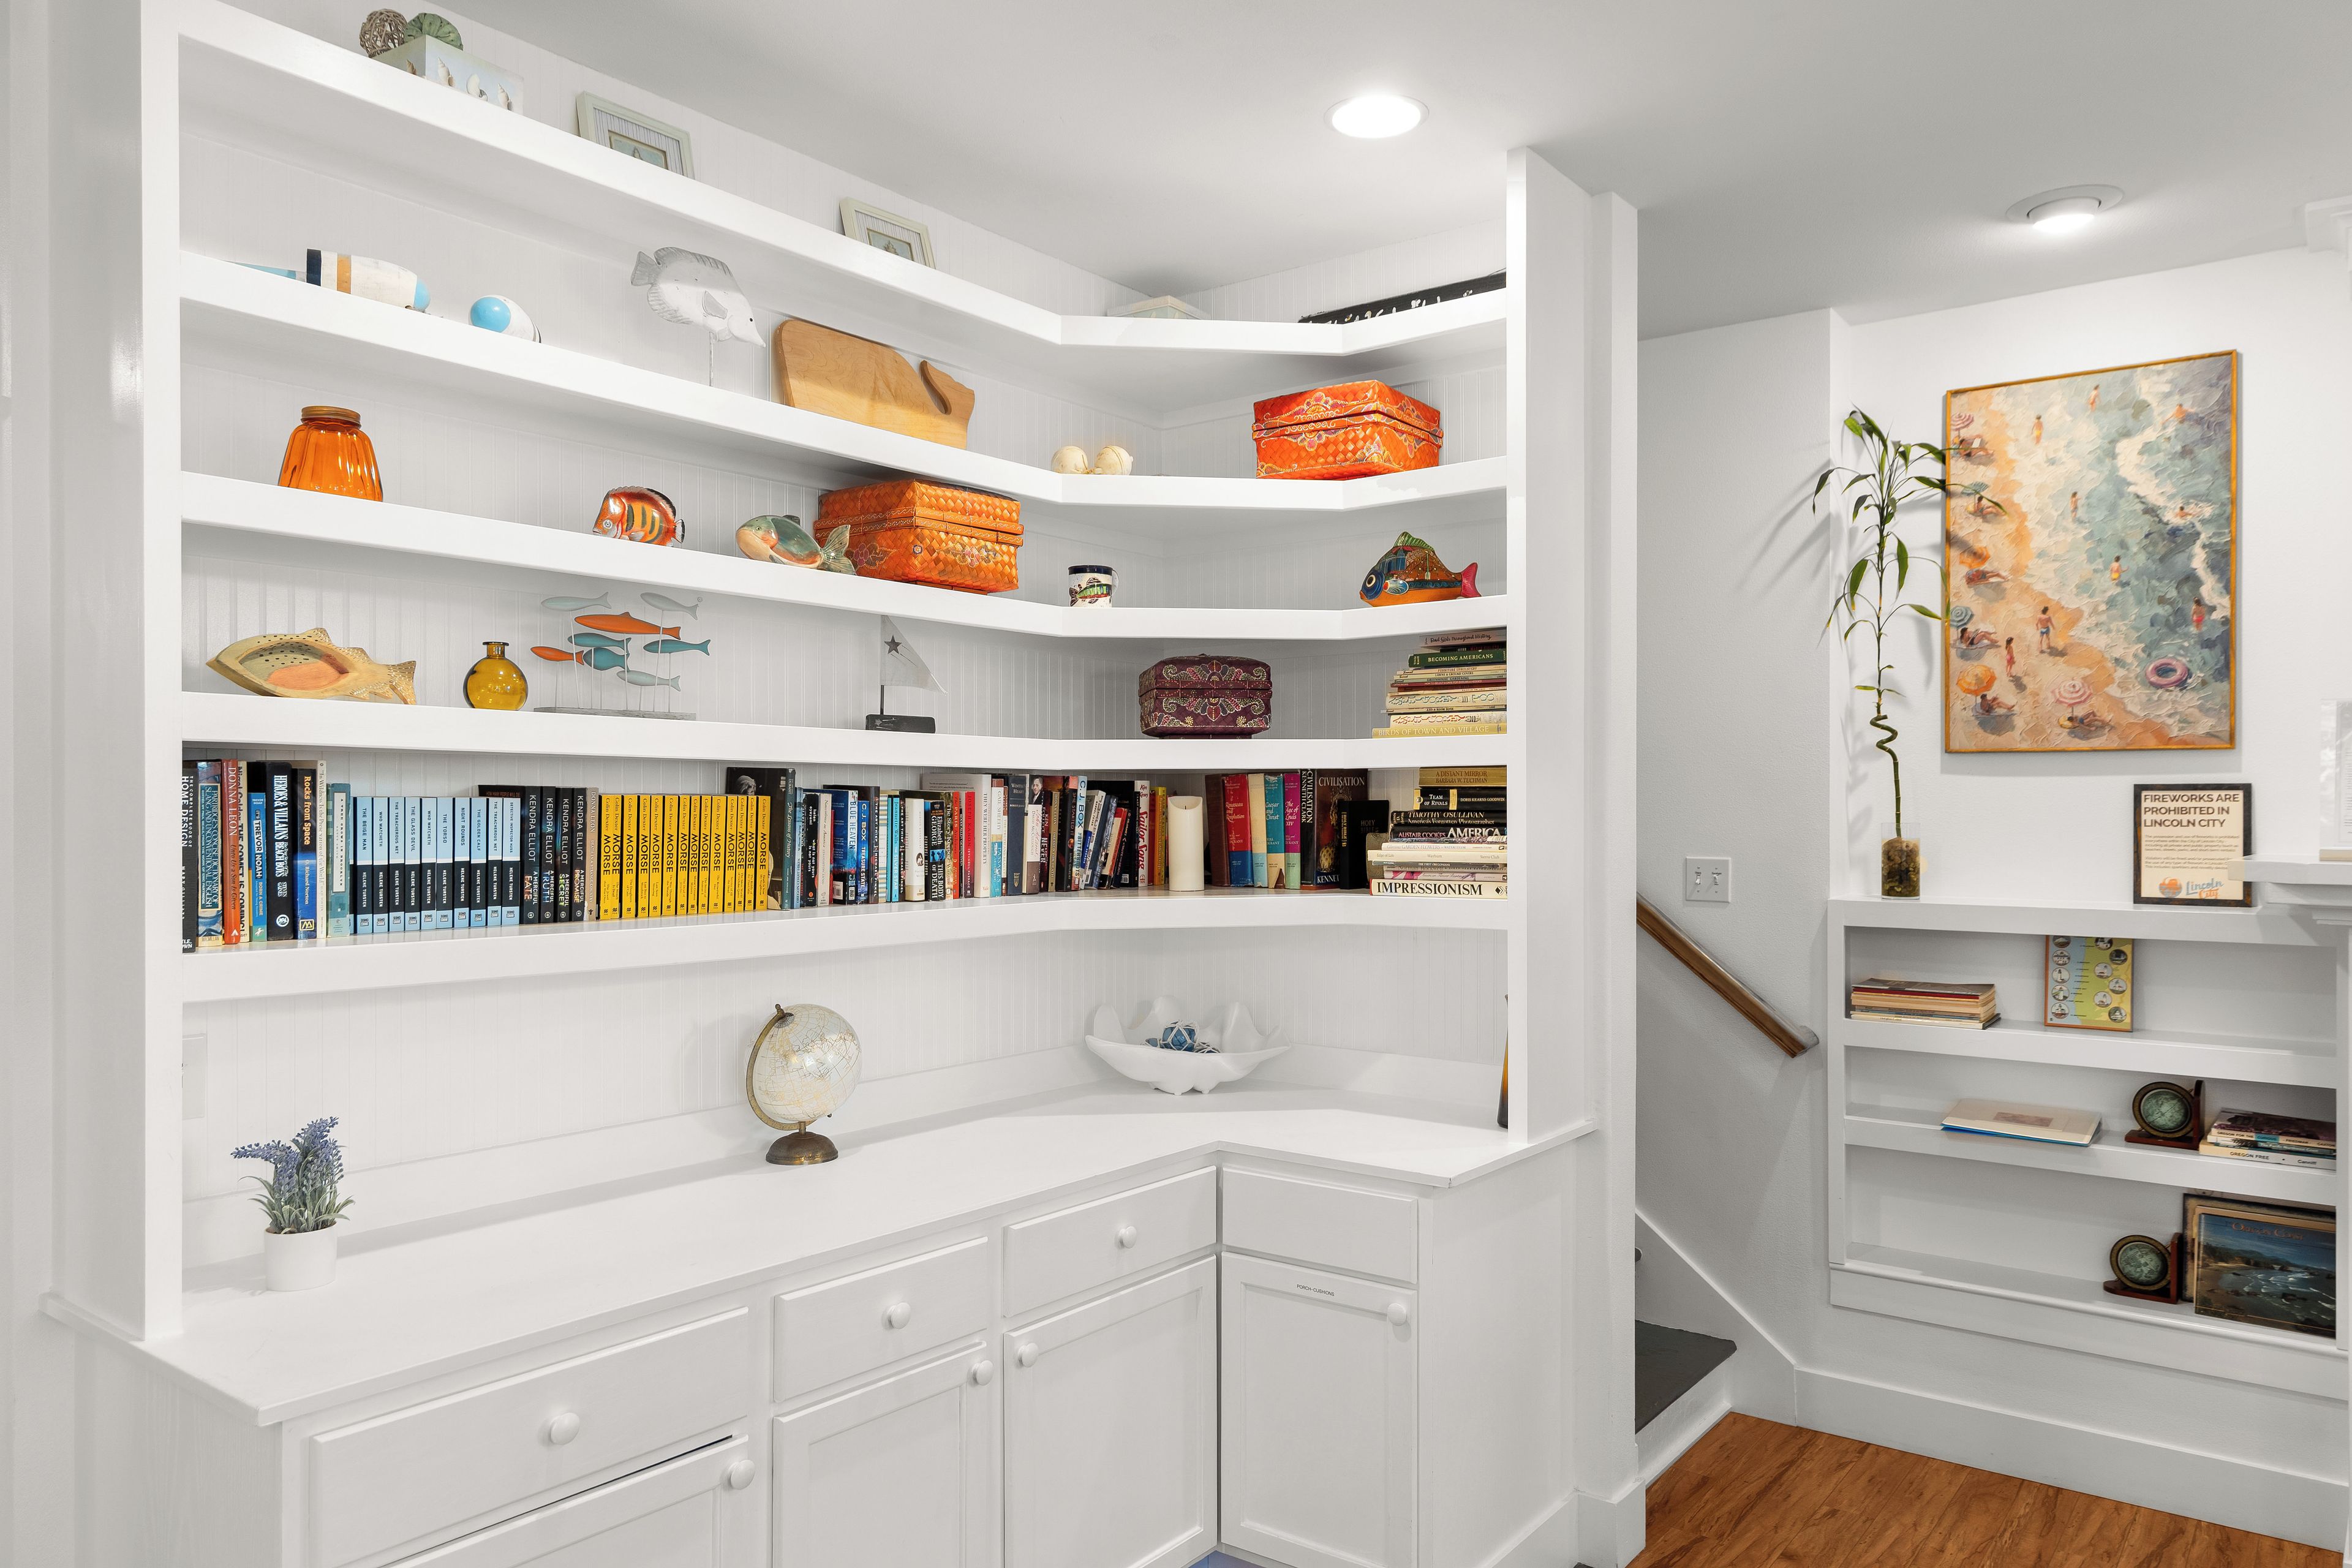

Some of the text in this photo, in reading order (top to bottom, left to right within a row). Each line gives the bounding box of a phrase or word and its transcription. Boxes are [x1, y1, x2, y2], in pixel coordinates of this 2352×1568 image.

[1079, 780, 1086, 790] C.
[1319, 777, 1365, 786] CIVILISATION
[274, 775, 288, 800] HEROES
[228, 767, 238, 836] DONNA LEON
[2144, 794, 2214, 802] FIREWORKS
[861, 804, 867, 812] C.
[274, 808, 288, 840] VILLAINS
[1226, 814, 1245, 823] Revolution
[2144, 819, 2196, 827] LINCOLN
[303, 823, 311, 845] Space
[1448, 827, 1501, 838] AMERICA
[1139, 810, 1148, 870] Sailor Song
[276, 842, 284, 877] BEACH BOYS
[239, 881, 245, 891] IS
[1377, 882, 1483, 895] IMPRESSIONISM
[2186, 878, 2224, 895] Lincoln
[211, 894, 219, 904] OF
[2199, 888, 2219, 899] City
[1297, 1284, 1335, 1297] PORCH-CUSHIONS
